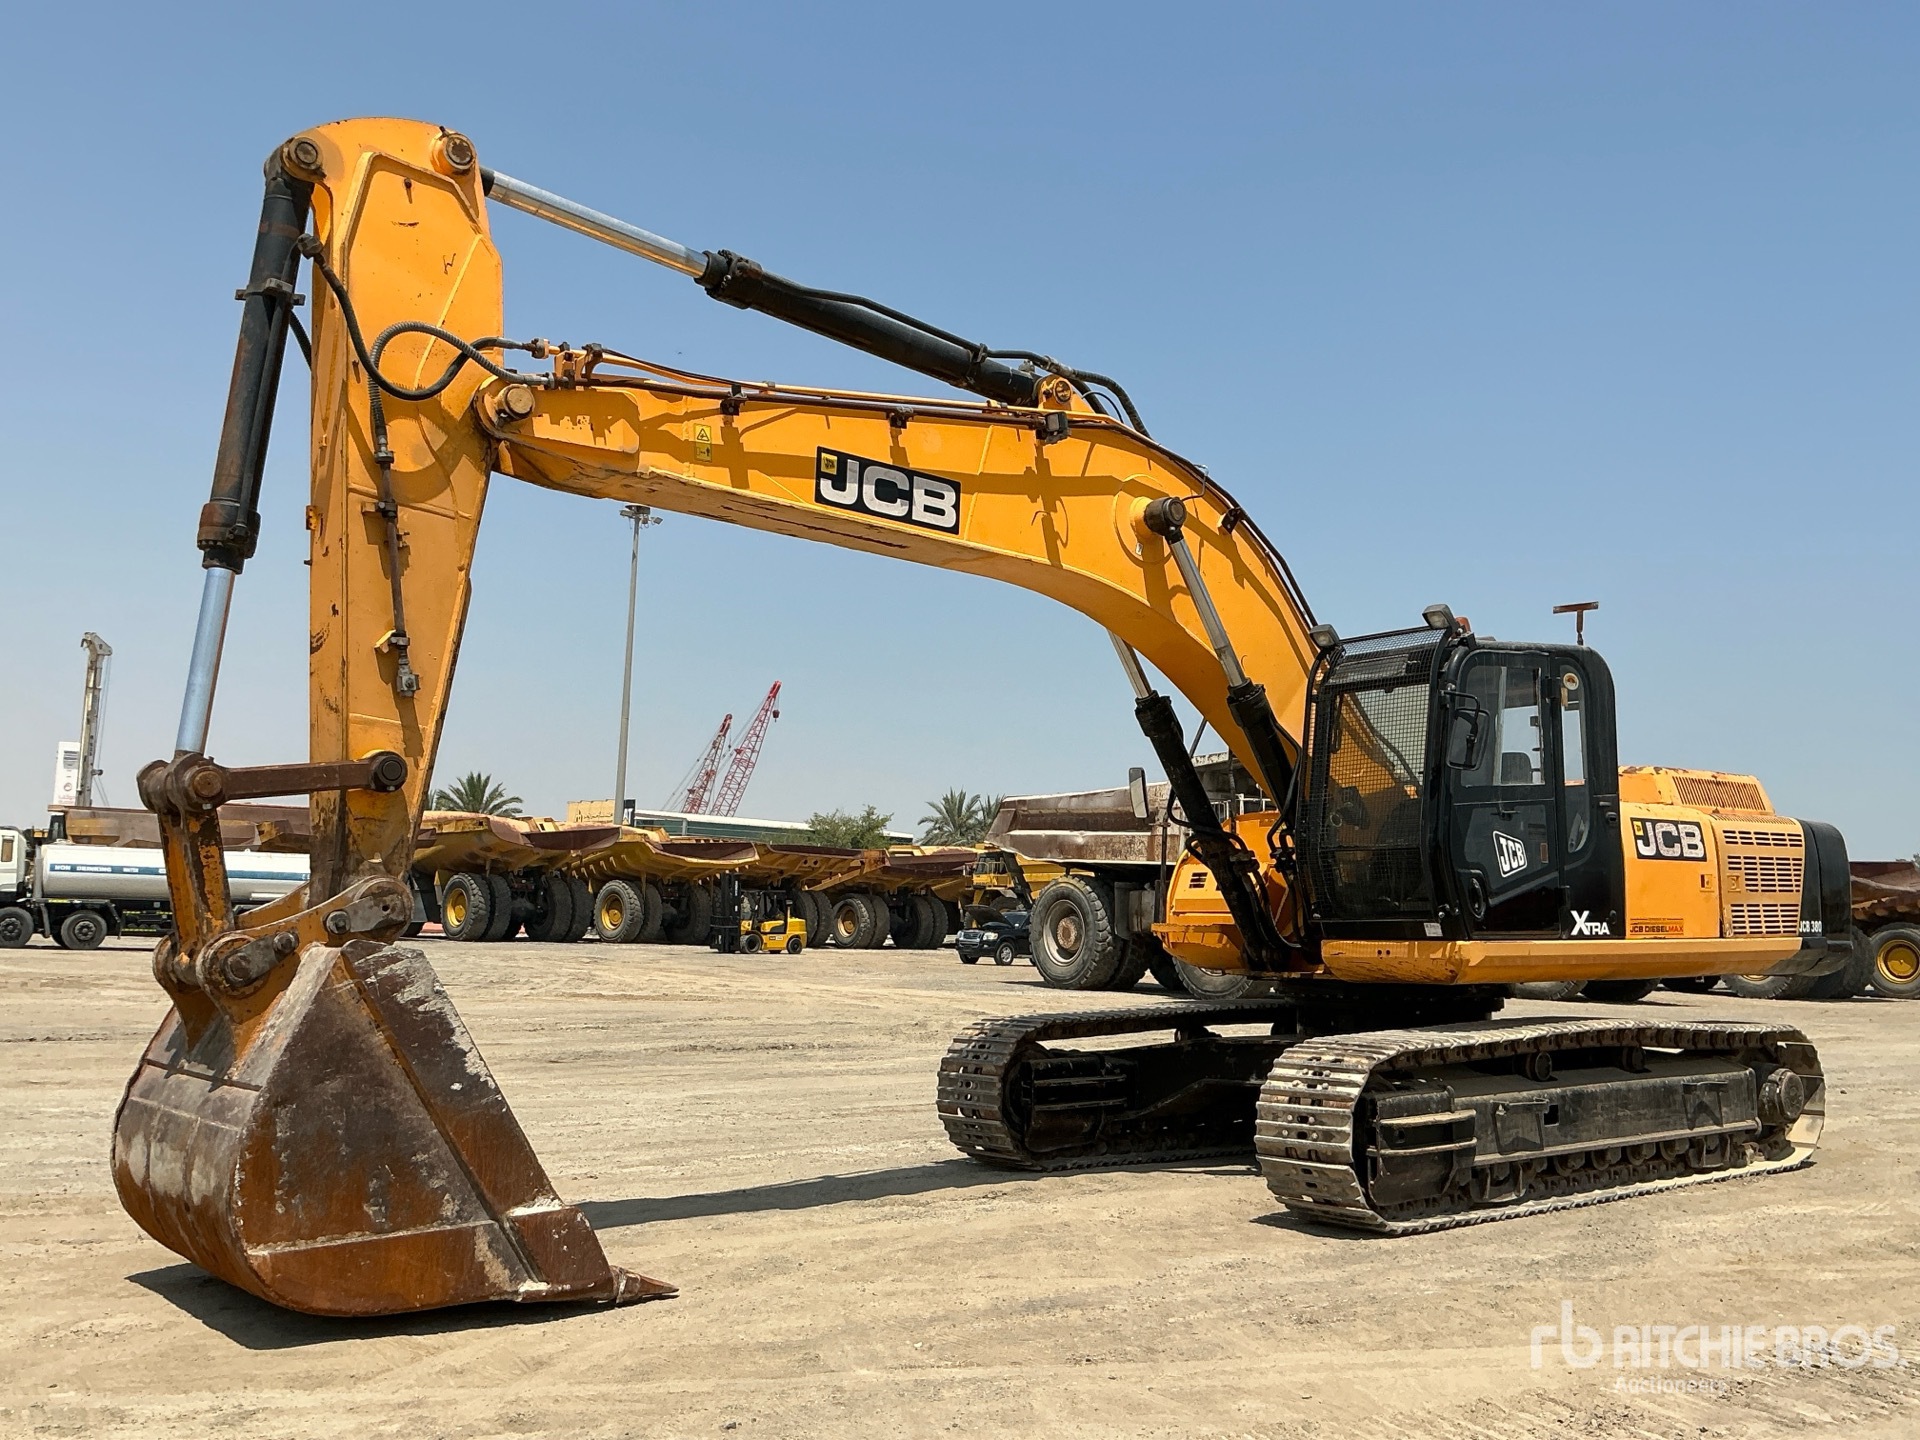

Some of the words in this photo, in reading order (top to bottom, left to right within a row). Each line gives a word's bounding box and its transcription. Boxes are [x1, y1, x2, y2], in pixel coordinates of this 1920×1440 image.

[819, 459, 957, 528] JCB
[1499, 836, 1525, 872] JCB
[1636, 822, 1705, 858] JCB
[1630, 925, 1644, 933] JCB
[1645, 925, 1684, 933] DIESELMAX
[1799, 920, 1810, 933] JCB
